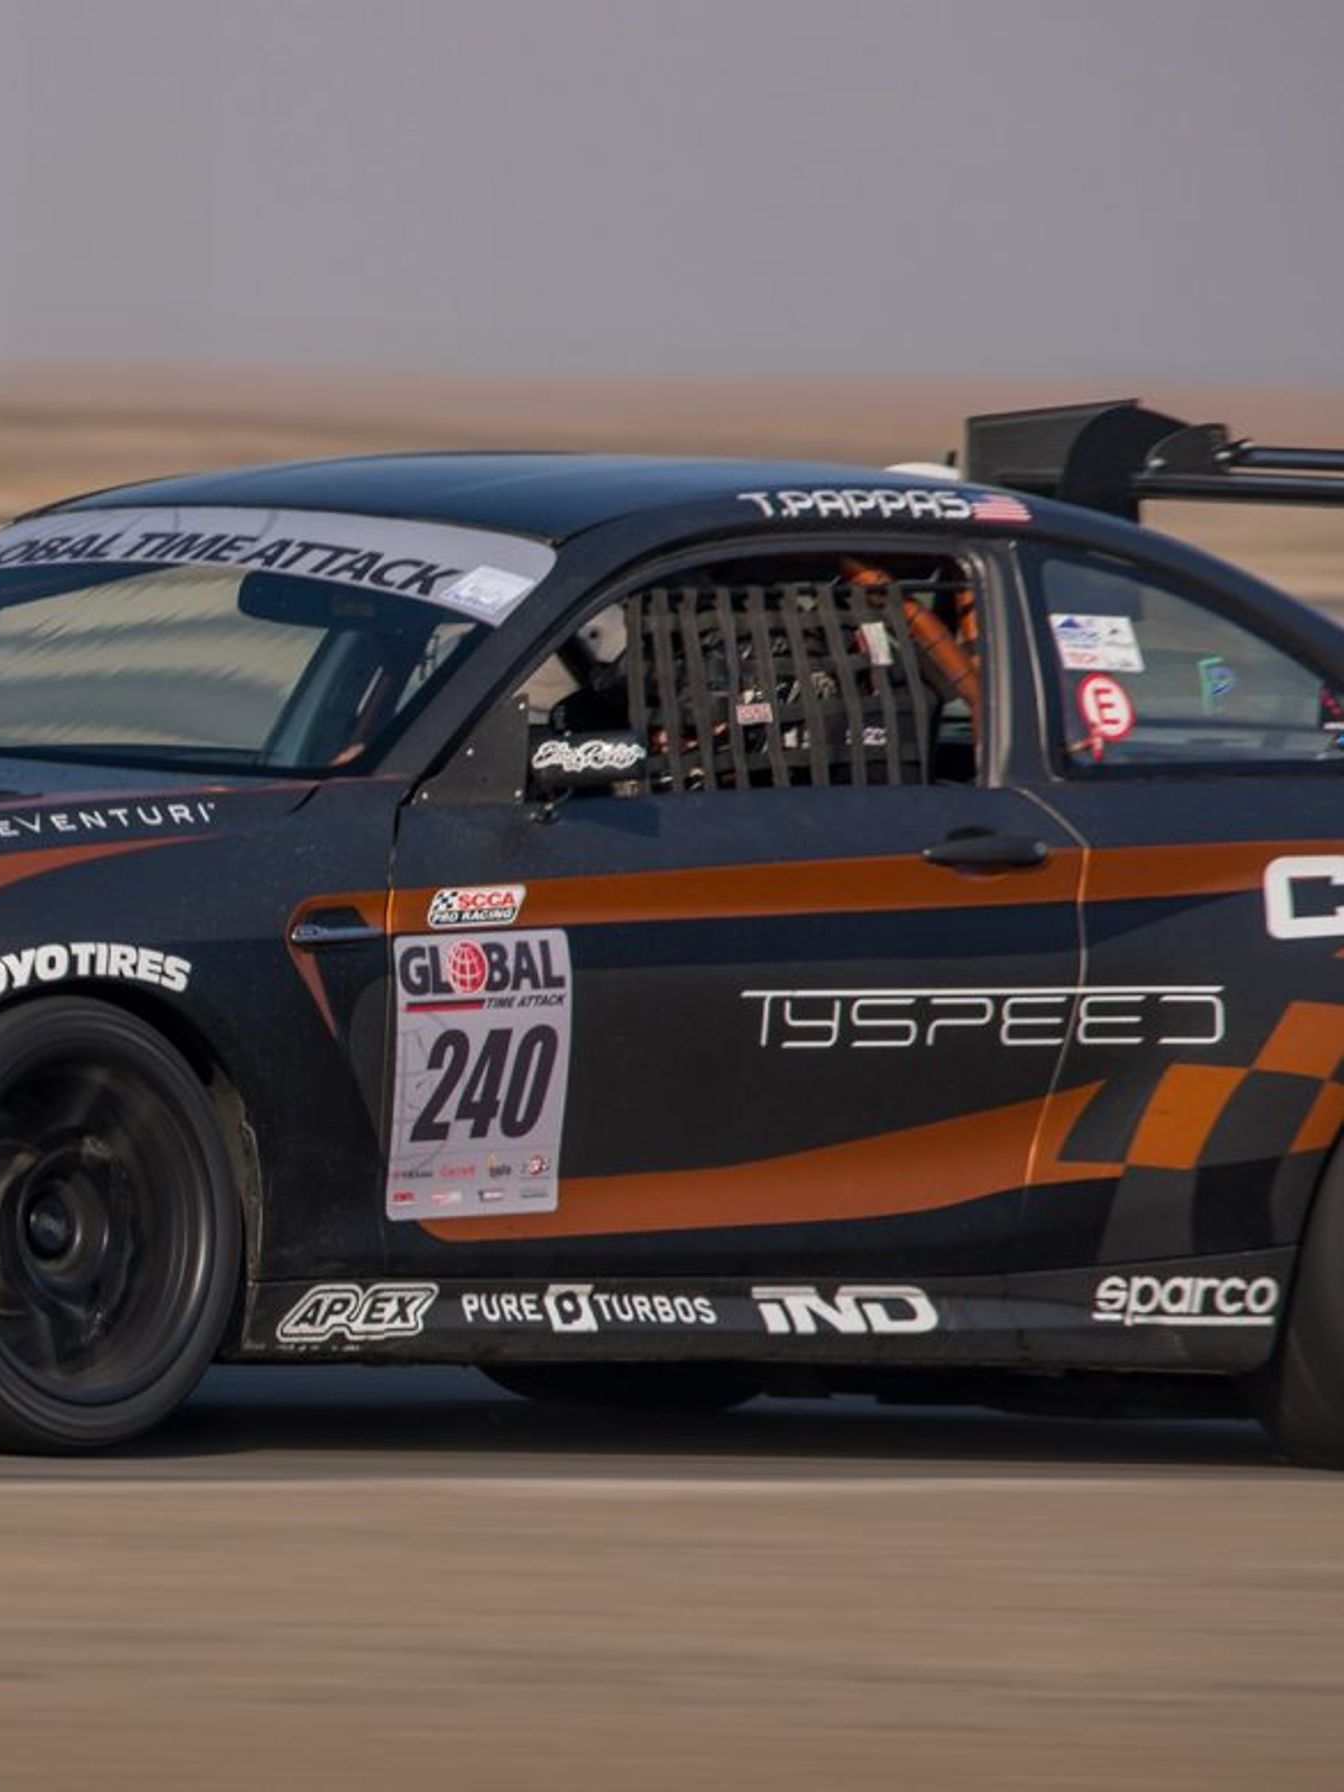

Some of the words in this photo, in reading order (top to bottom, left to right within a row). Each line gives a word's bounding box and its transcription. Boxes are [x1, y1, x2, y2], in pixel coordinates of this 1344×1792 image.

[120, 532, 260, 564] TIME
[244, 537, 466, 597] ATTACK
[457, 891, 515, 909] SCCA
[69, 942, 193, 993] TIRES
[399, 938, 566, 996] GLOBAL
[486, 997, 519, 1010] TIME
[517, 994, 567, 1009] ATTACK
[409, 1023, 560, 1144] 240
[286, 1290, 428, 1334] APEX
[461, 1293, 544, 1323] PURE
[592, 1294, 718, 1325] TURBOS
[1093, 1275, 1280, 1327] sparco
